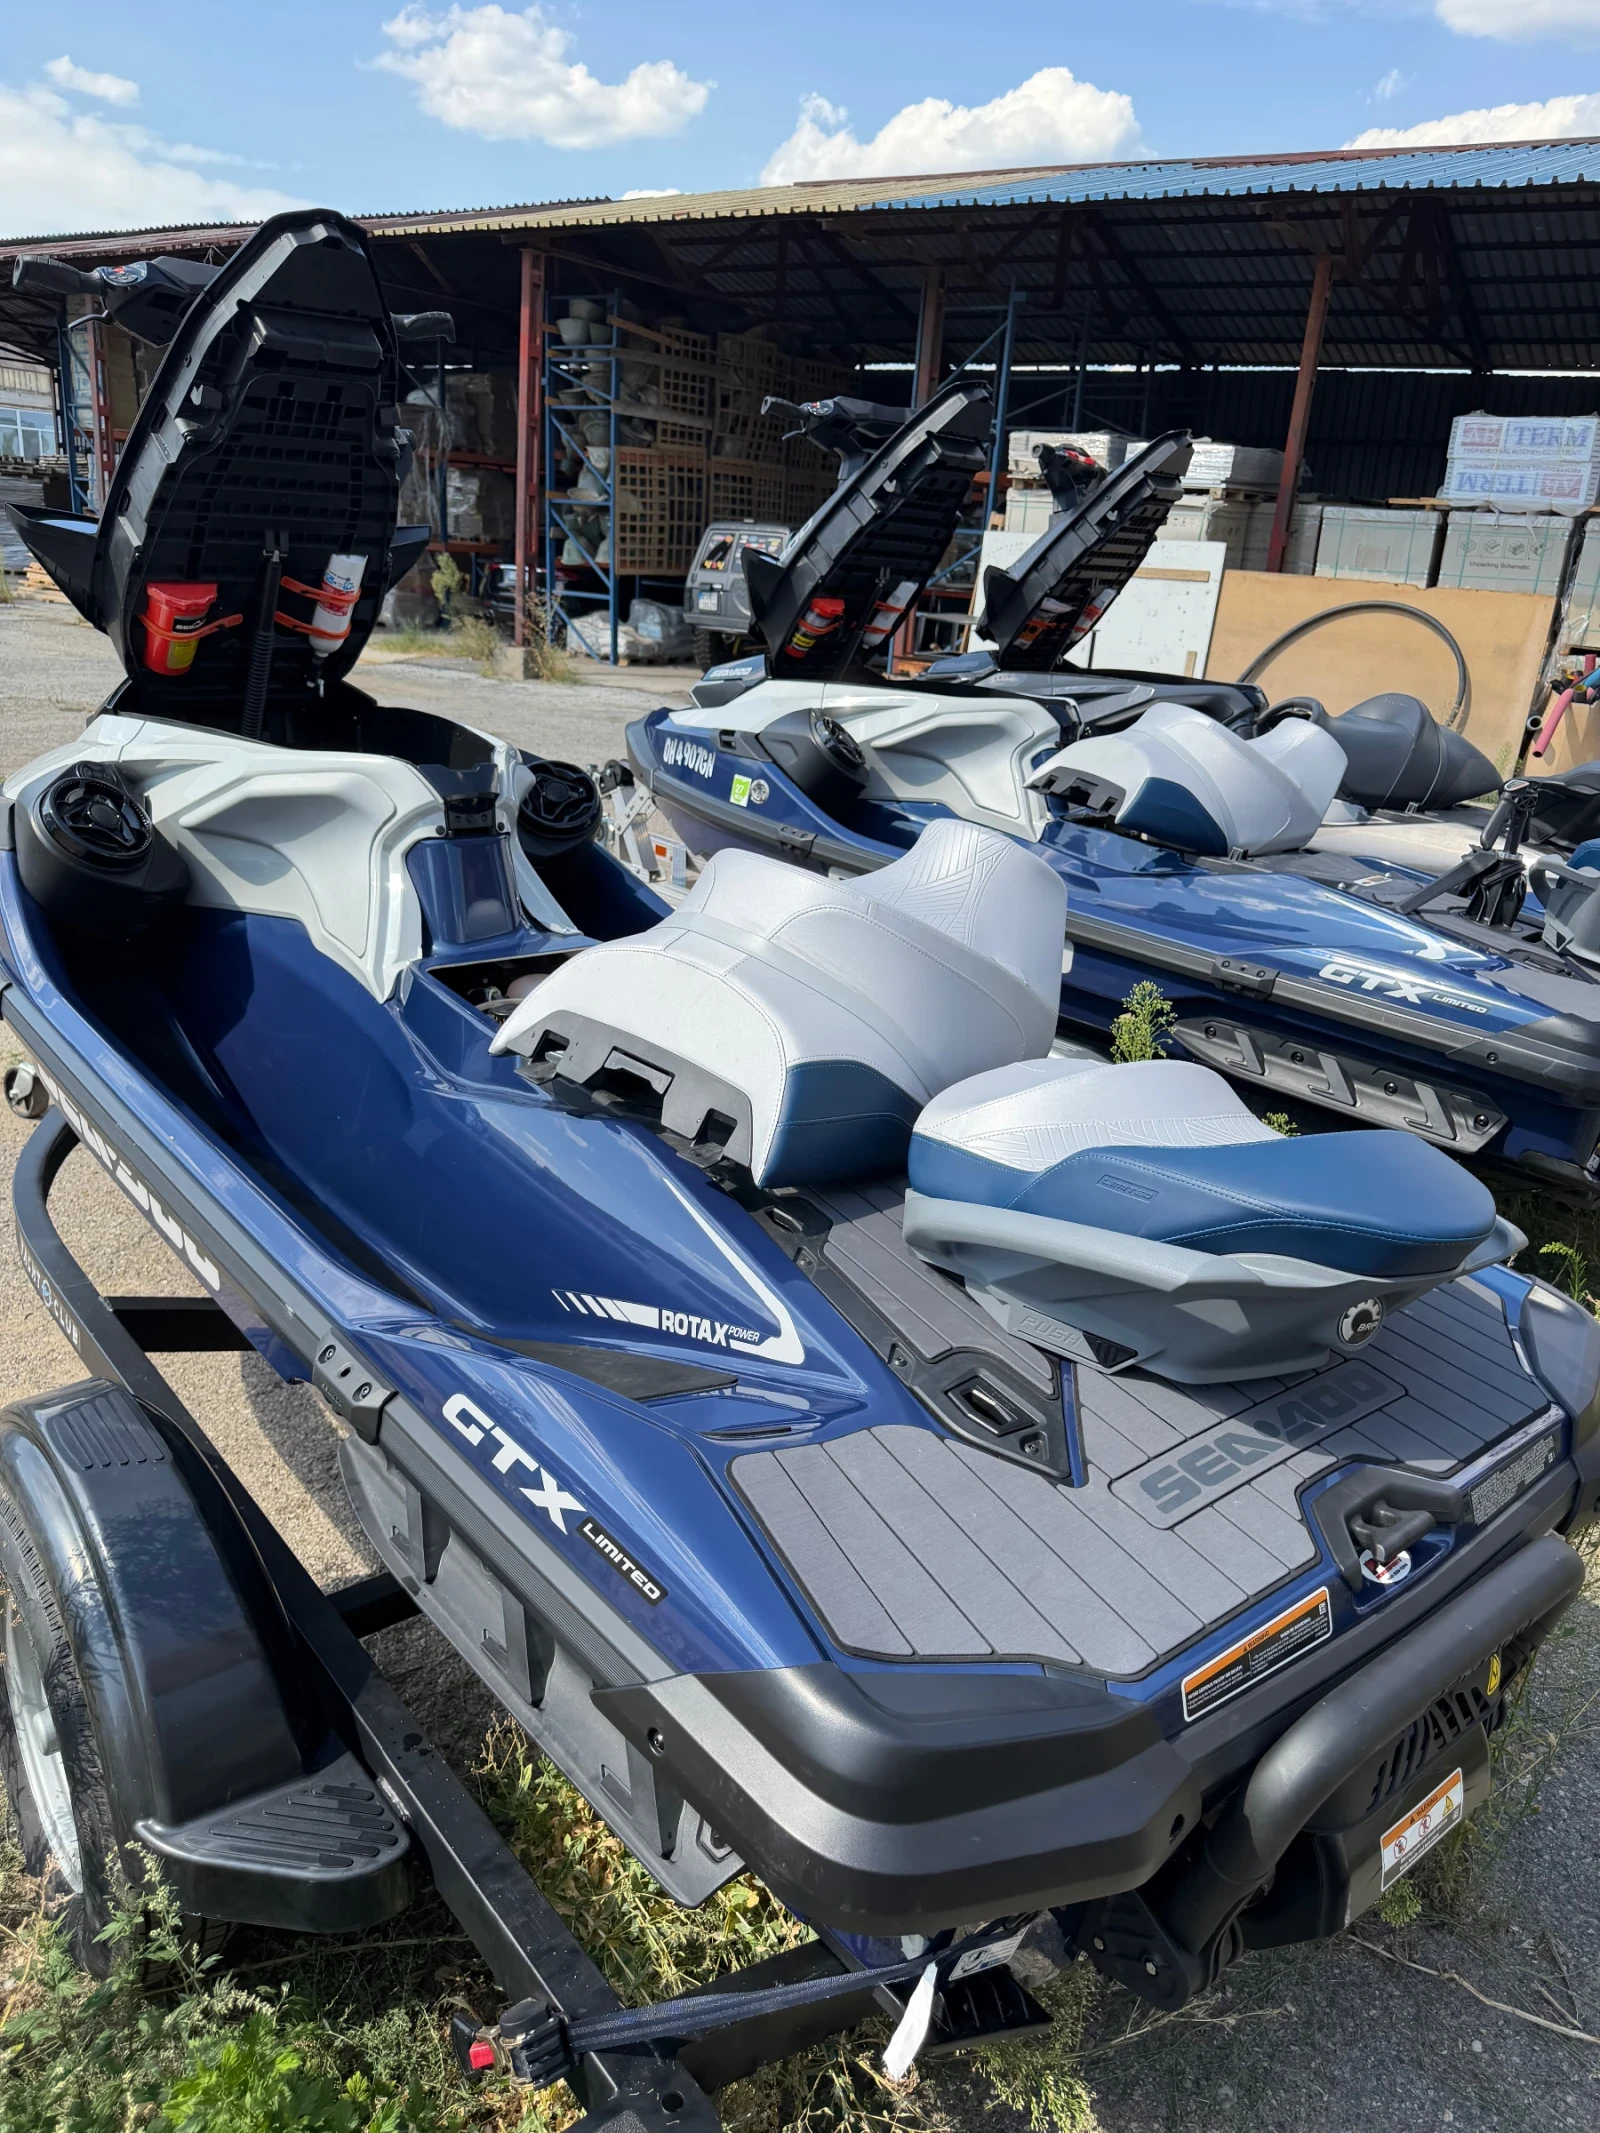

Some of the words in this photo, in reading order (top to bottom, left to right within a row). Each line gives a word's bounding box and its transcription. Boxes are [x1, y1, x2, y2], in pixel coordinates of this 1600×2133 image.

[1513, 424, 1592, 447] TERM
[1457, 472, 1529, 494] TERM
[1469, 560, 1499, 570] Unpacking
[1500, 562, 1531, 570] Schematic
[735, 783, 744, 793] 27
[1318, 963, 1434, 1005] GTX
[1432, 993, 1488, 1014] LIMITED
[1101, 1178, 1154, 1200] LIMITED
[53, 1299, 79, 1345] CLUB
[661, 1309, 729, 1347] ROTAX
[728, 1325, 760, 1343] POWER
[1020, 1315, 1084, 1347] PUSH
[1356, 1321, 1379, 1332] BRP
[442, 1393, 587, 1536] GTX
[582, 1522, 661, 1600] LIMITED
[1247, 1630, 1270, 1649] WARNING
[1416, 1794, 1439, 1817] WARNING
